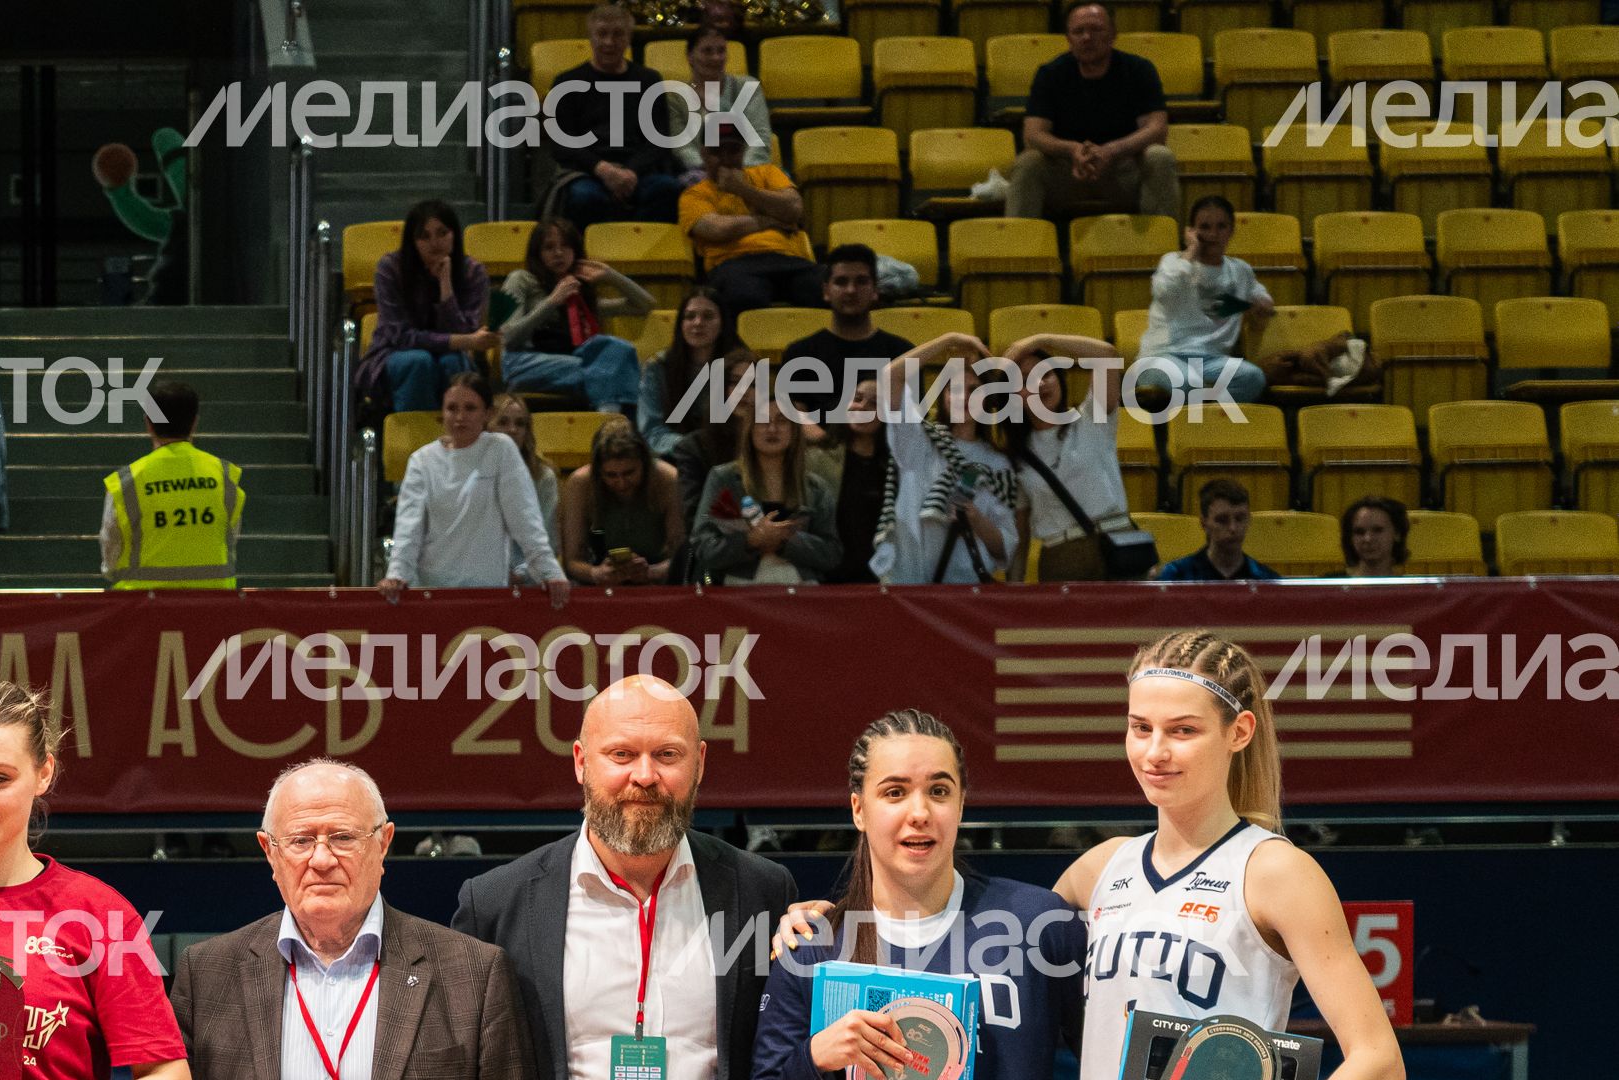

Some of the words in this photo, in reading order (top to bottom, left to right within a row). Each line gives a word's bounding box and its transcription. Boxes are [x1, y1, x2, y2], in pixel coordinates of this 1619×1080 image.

[144, 477, 218, 496] STEWARD
[173, 506, 215, 527] 216
[1179, 902, 1221, 923] АСБ
[1152, 1019, 1173, 1028] CITY
[1174, 1023, 1190, 1032] BO
